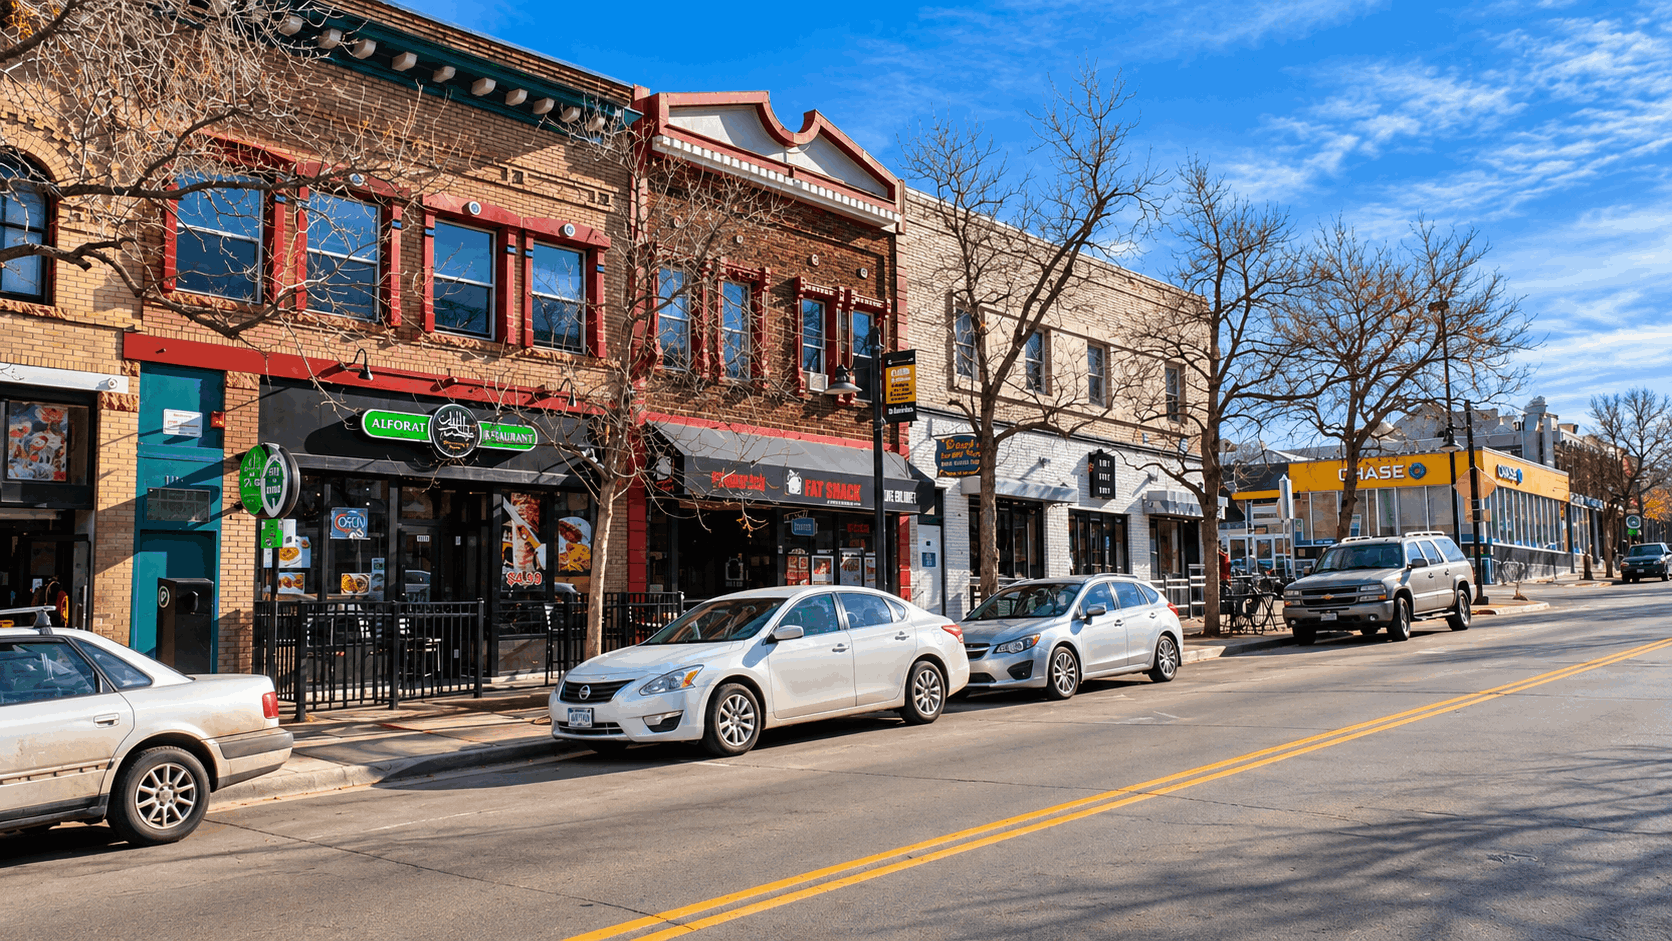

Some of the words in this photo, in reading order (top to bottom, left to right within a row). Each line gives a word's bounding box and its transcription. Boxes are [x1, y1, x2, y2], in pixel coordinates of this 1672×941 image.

[371, 418, 426, 433] ALFORAT
[1338, 465, 1405, 481] CHASE
[804, 479, 824, 498] FAT
[826, 481, 862, 502] SHACK
